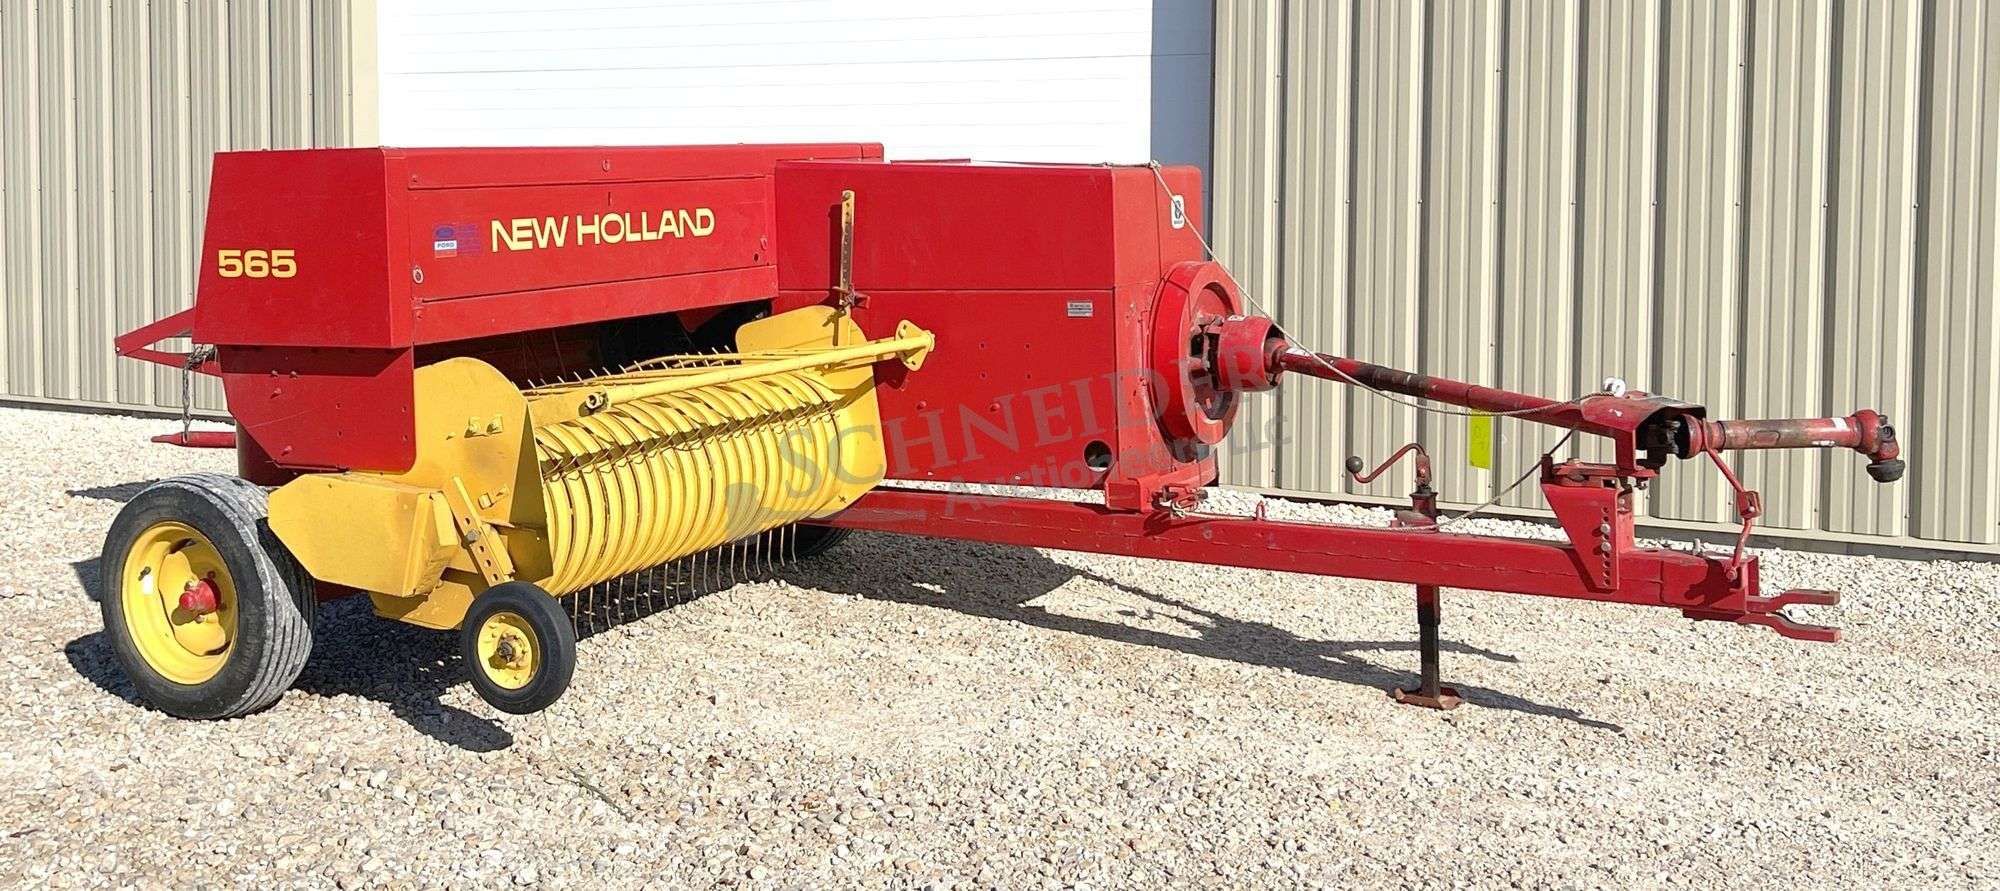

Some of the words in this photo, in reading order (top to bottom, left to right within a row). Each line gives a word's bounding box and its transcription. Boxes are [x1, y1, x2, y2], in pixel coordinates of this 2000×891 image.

[491, 215, 570, 253] NEW
[576, 207, 716, 246] HOLLAND
[218, 249, 297, 278] 565
